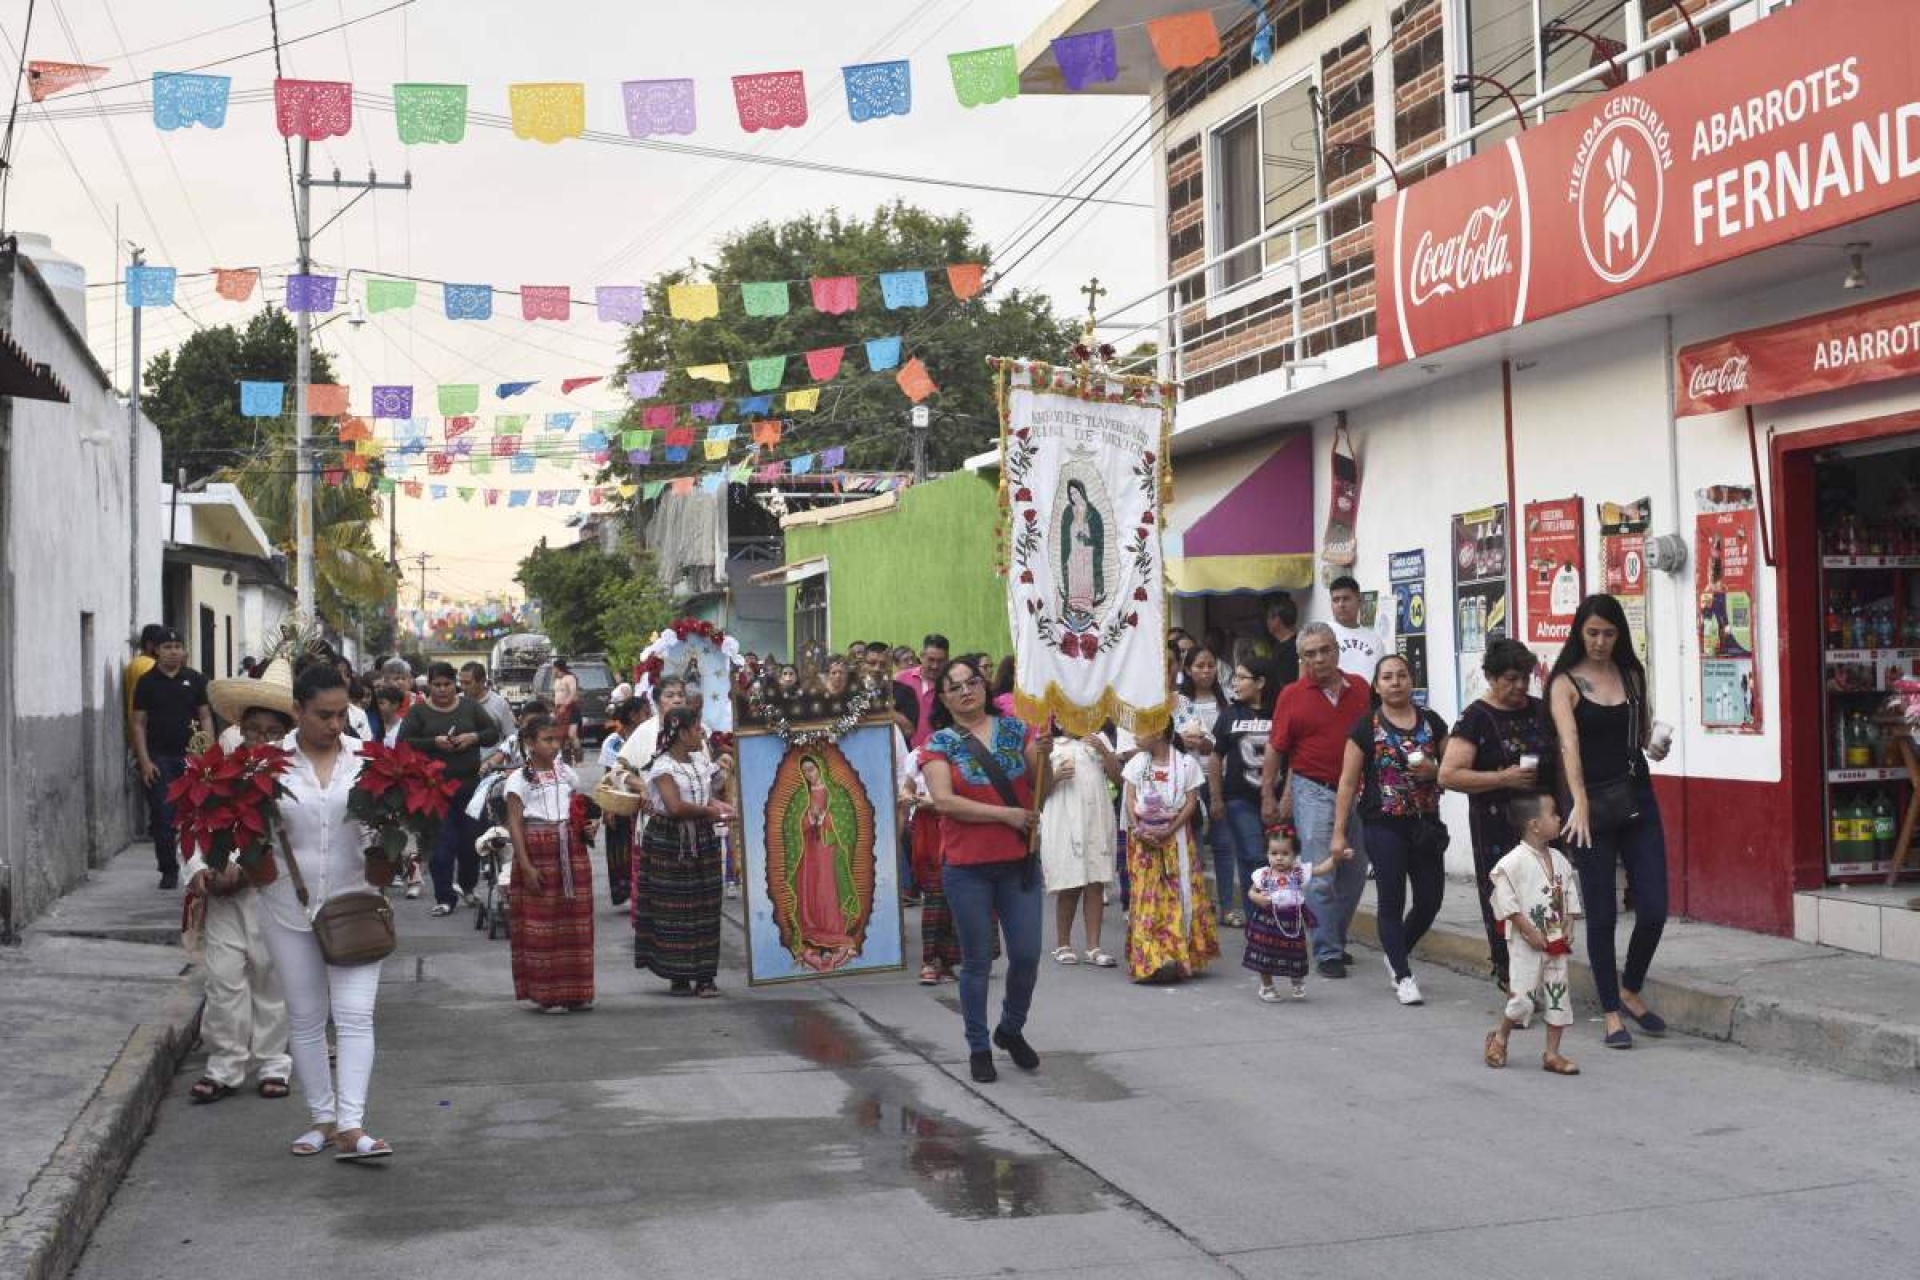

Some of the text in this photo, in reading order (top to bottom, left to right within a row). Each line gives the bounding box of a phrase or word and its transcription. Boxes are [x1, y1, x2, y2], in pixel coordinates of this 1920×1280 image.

[1568, 95, 1673, 203] TIENDA CENTURIÓN
[1691, 56, 1860, 161] ABARROTES
[1410, 196, 1513, 306] Coca-Cola
[1689, 354, 1749, 399] Coca-Cola
[1814, 320, 1920, 371] ABARROT
